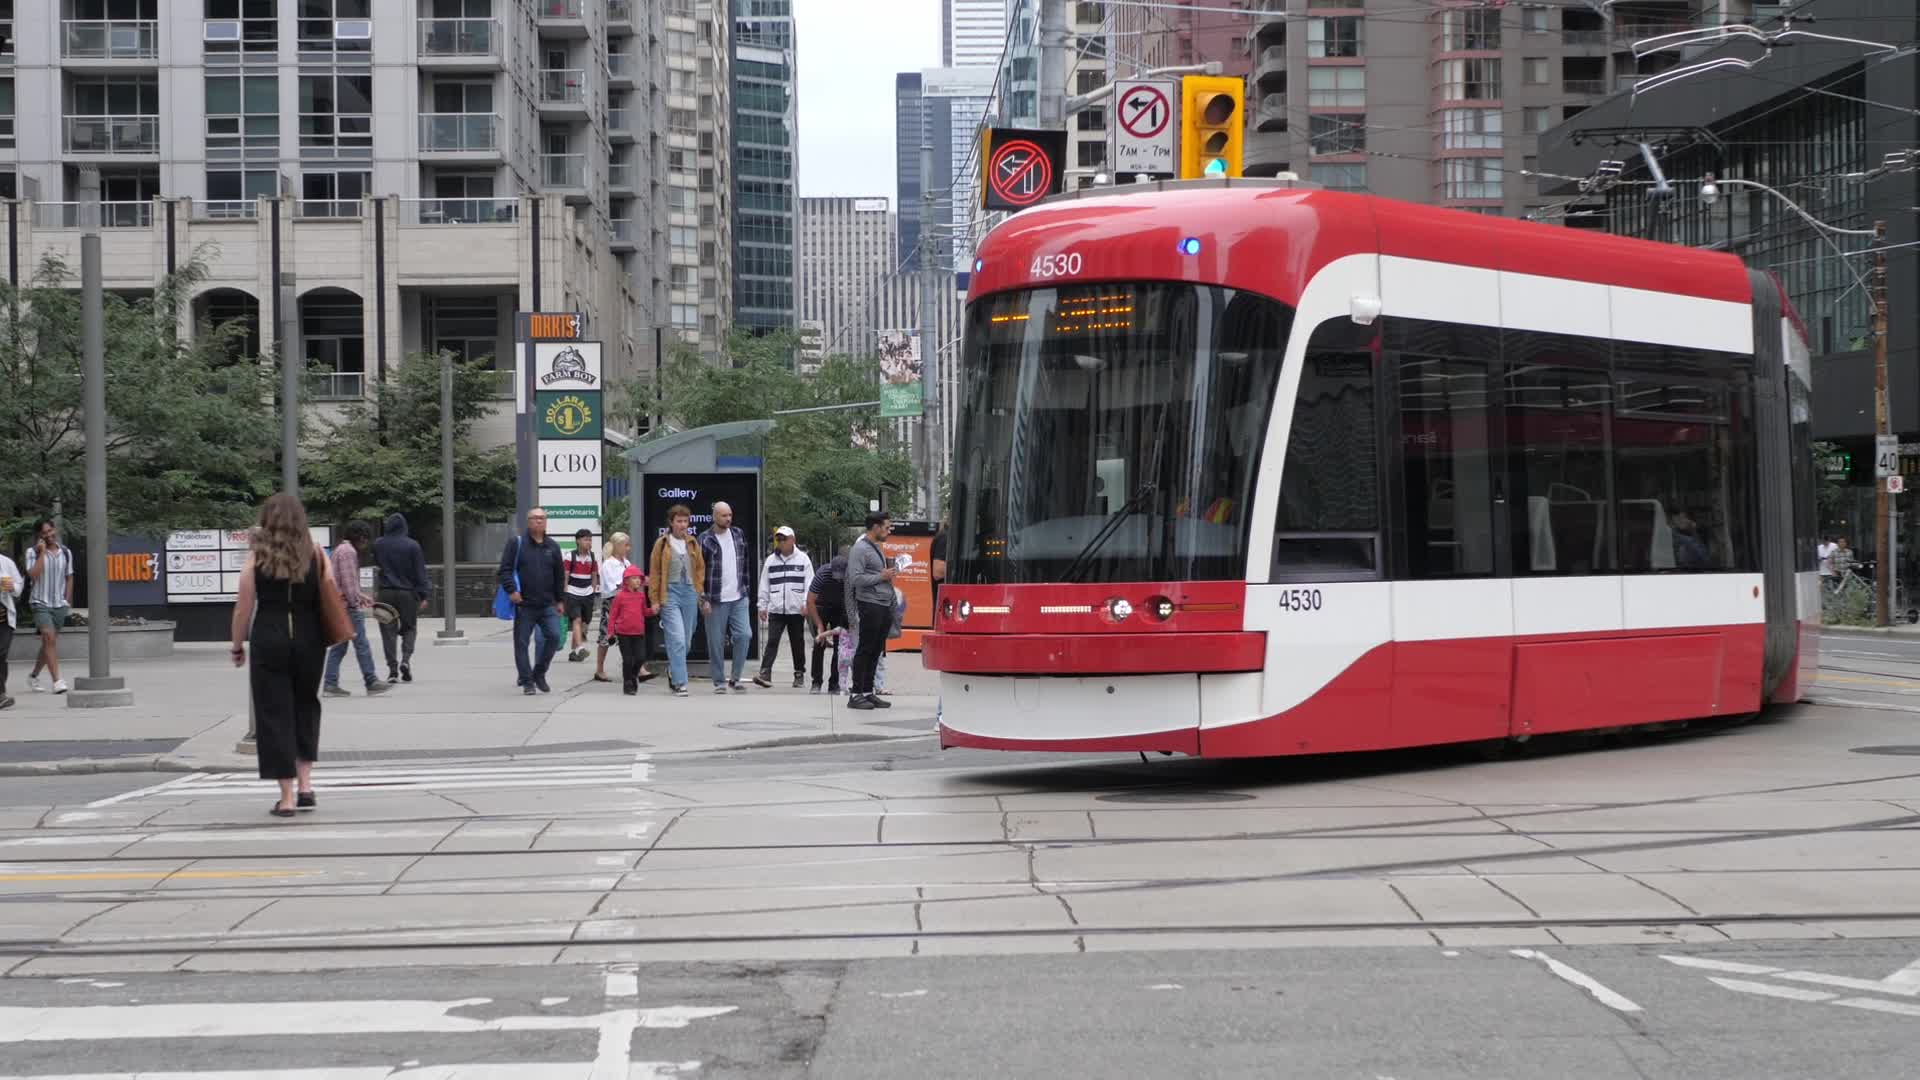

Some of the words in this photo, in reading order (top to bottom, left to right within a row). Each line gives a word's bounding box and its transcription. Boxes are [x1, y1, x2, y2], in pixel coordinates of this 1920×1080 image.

[1120, 144, 1138, 157] 7AM
[1152, 144, 1171, 157] 7PM
[1030, 252, 1082, 277] 4530
[542, 370, 572, 384] FARM
[573, 371, 595, 384] BOY
[545, 395, 592, 424] DOLLARAMA
[543, 454, 597, 473] LCBO
[1879, 452, 1897, 472] 40
[658, 487, 698, 500] Gallery
[175, 575, 215, 588] SALUS
[1279, 589, 1322, 611] 4530
